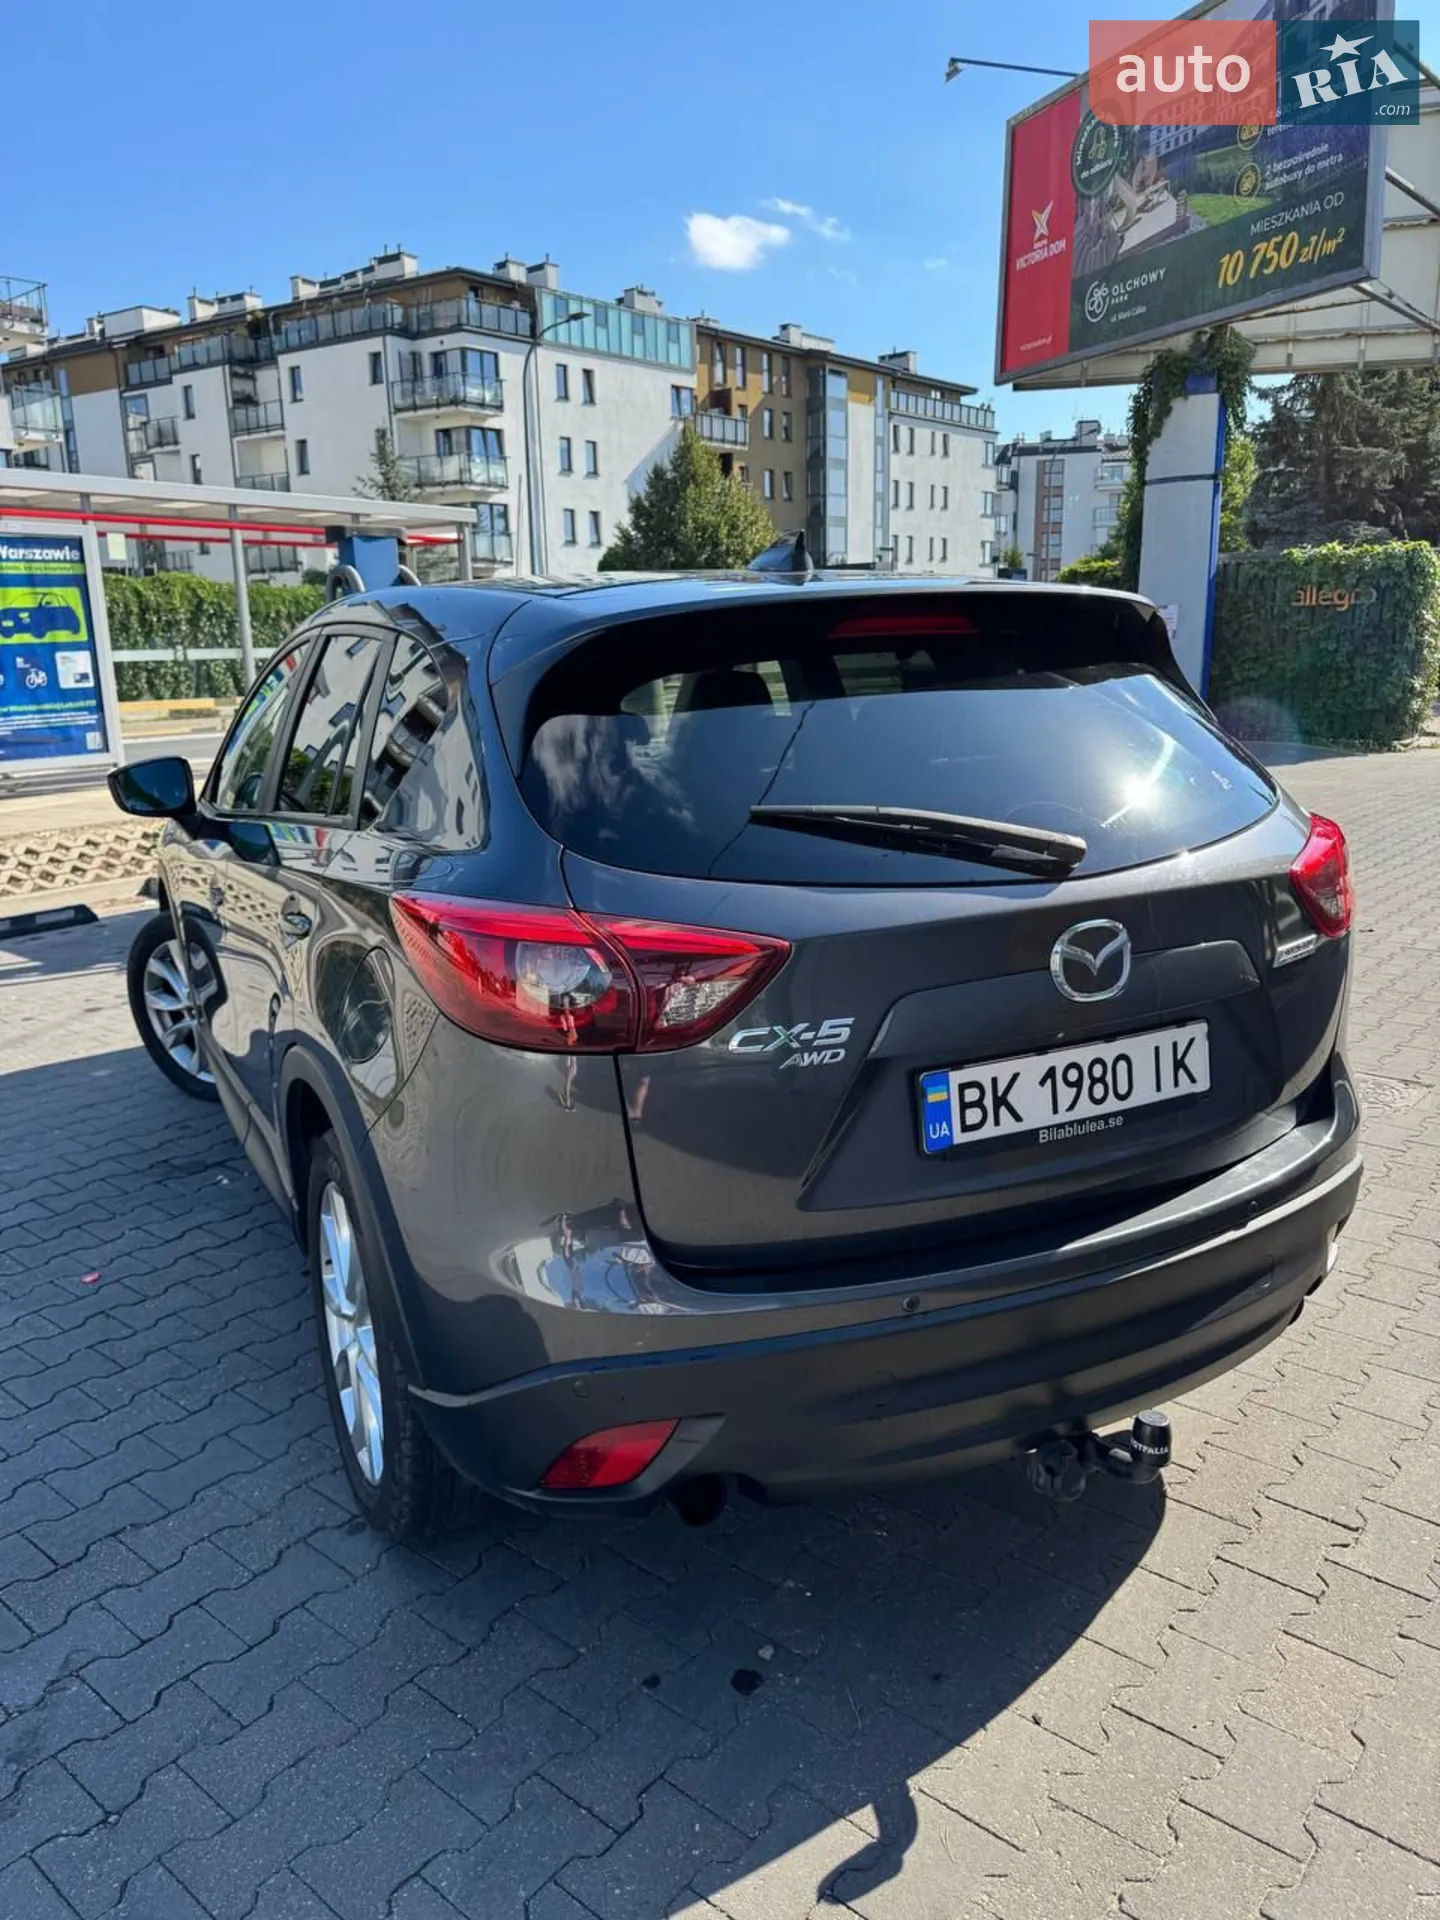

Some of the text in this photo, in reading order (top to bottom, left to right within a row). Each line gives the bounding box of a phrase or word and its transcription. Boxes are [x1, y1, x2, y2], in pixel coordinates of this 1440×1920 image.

[1304, 163, 1316, 175] do
[1316, 153, 1344, 171] metra
[1250, 191, 1345, 236] MIESZKANIA OD
[1218, 249, 1245, 289] 10
[1249, 231, 1299, 279] 750
[1112, 267, 1166, 296] OLCHOWY
[728, 1017, 856, 1054] CX-5
[779, 1048, 846, 1069] AWD
[957, 1037, 1198, 1133] BK 1980 IK
[929, 1121, 951, 1139] UA
